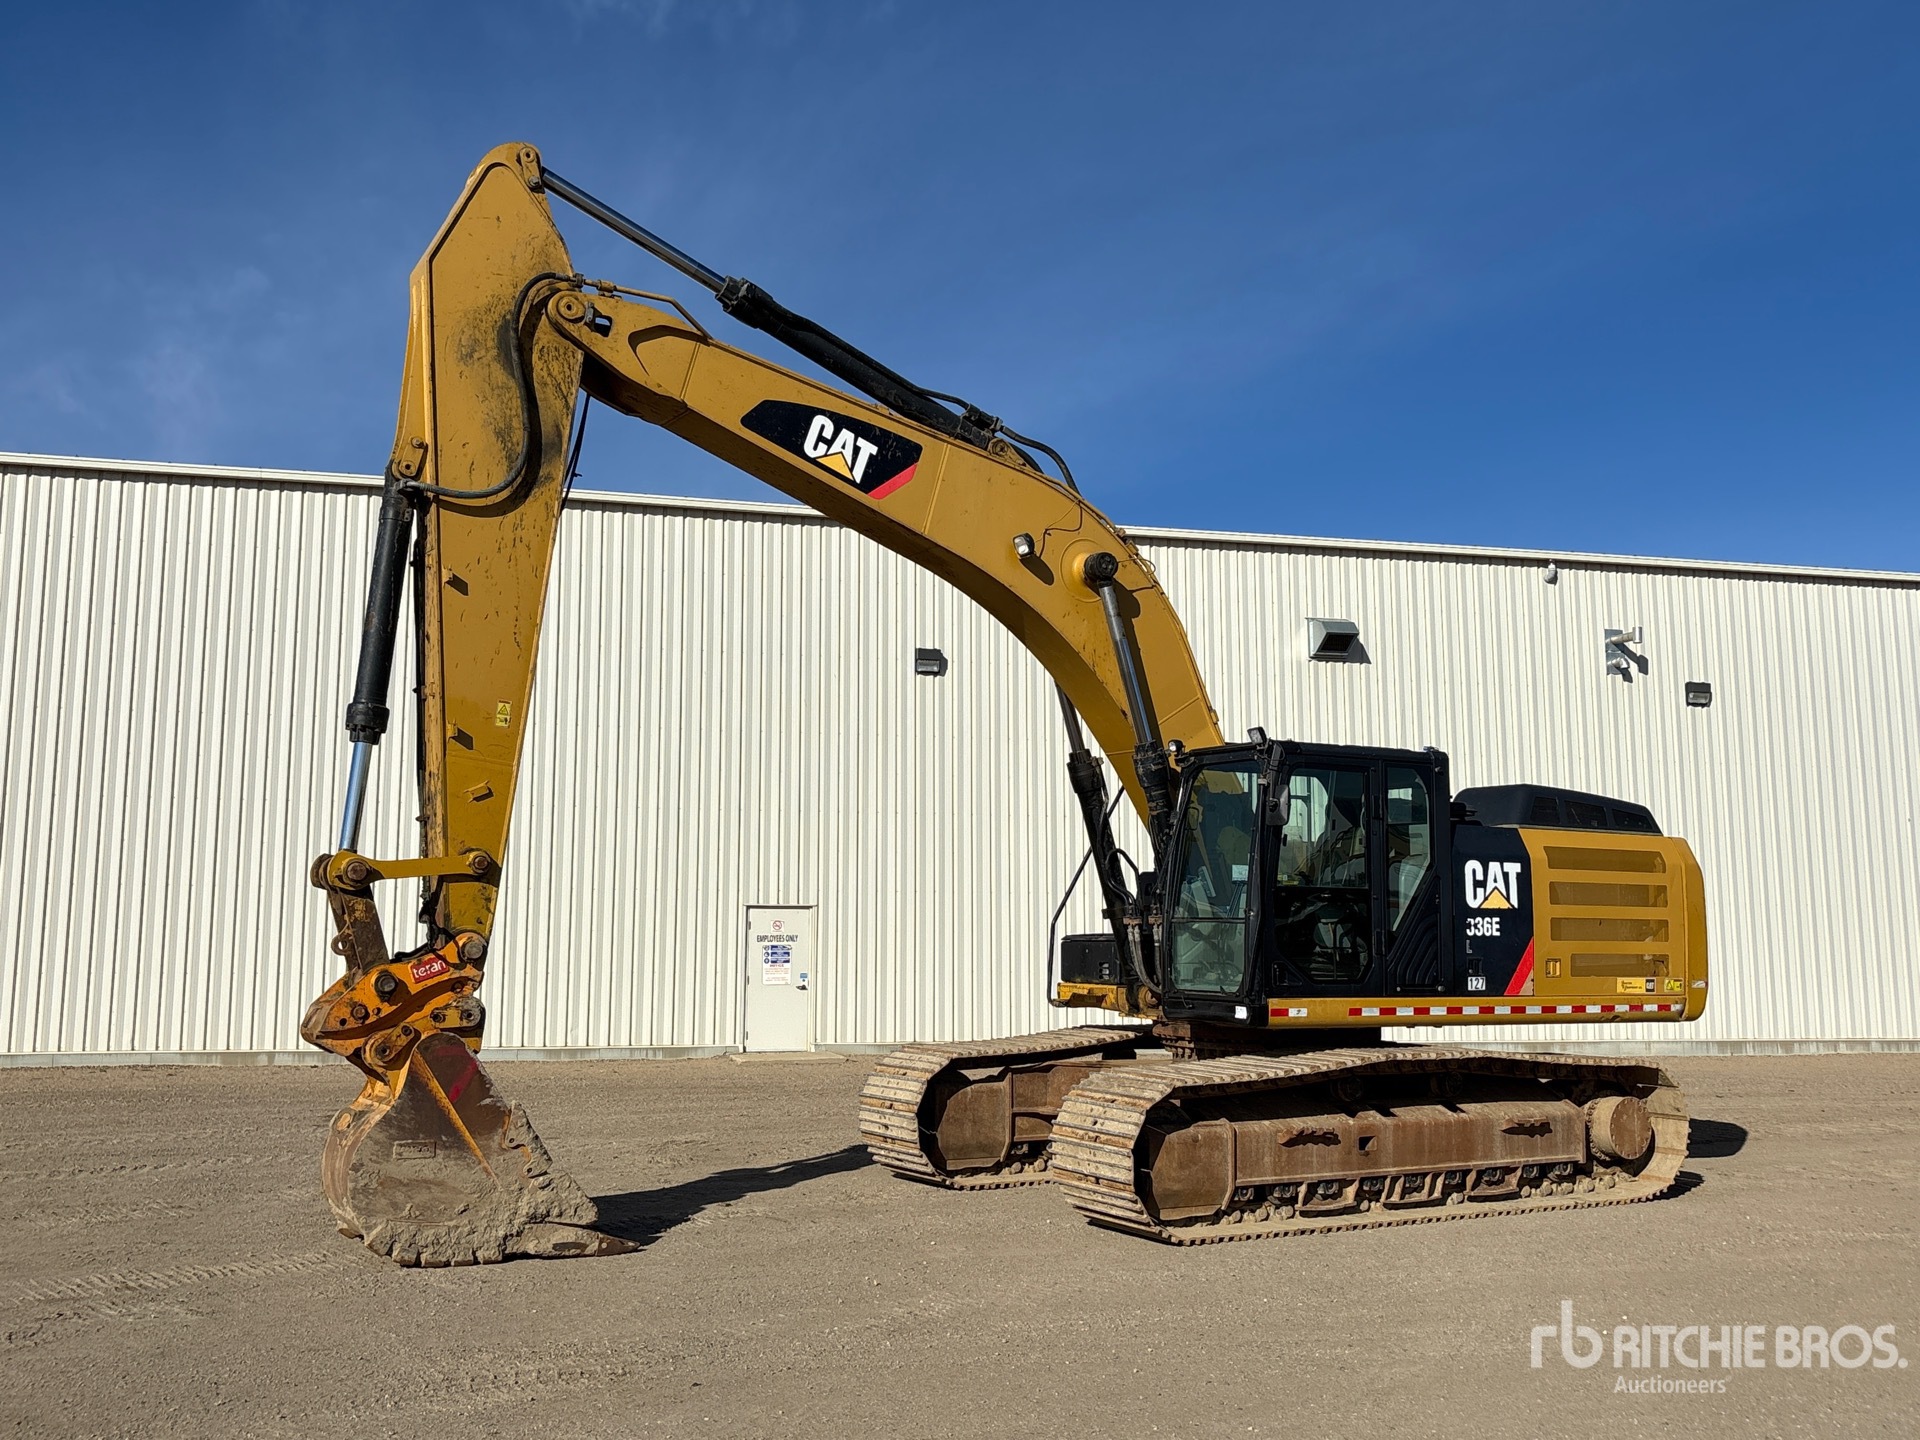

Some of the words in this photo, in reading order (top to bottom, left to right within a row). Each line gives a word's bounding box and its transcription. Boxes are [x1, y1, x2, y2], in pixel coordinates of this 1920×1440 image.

[803, 414, 878, 484] CAT
[1464, 859, 1521, 909] CAT
[1465, 916, 1501, 936] 336E
[1468, 977, 1485, 990] 127
